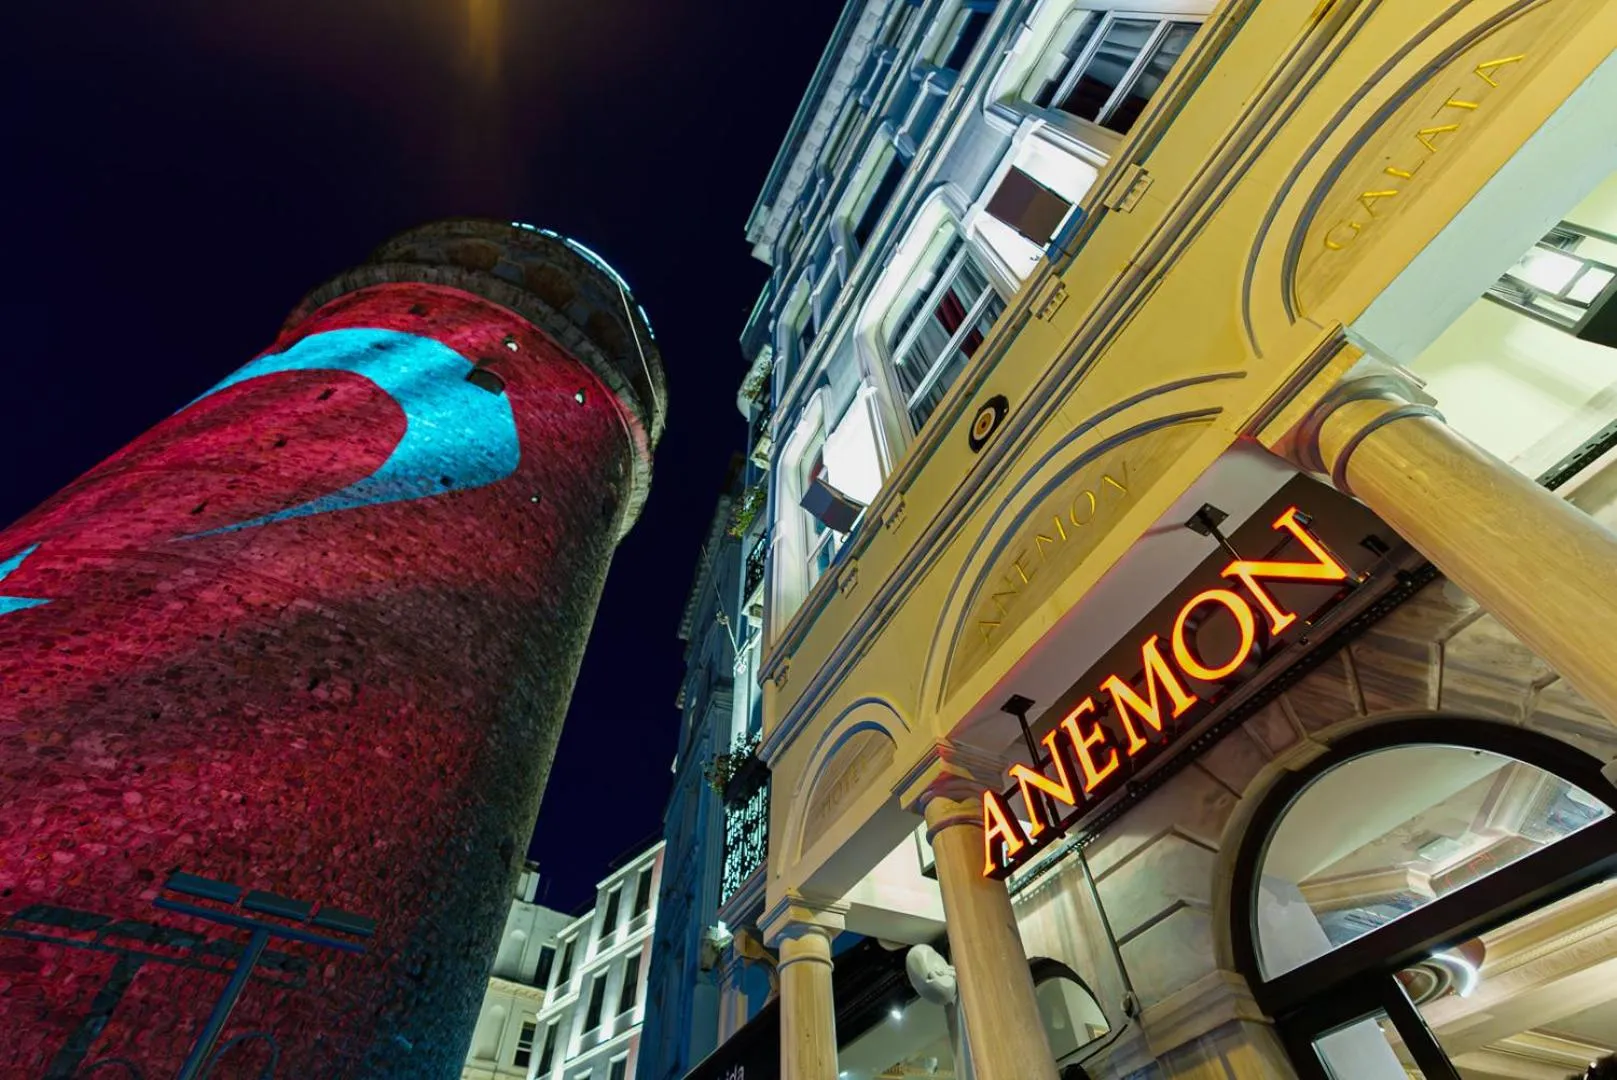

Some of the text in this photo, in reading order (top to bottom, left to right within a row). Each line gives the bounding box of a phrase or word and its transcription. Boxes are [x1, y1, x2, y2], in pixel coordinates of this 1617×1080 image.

[1323, 54, 1525, 250] GALATA
[978, 461, 1130, 645] ANEMON
[981, 506, 1350, 879] ANEMON
